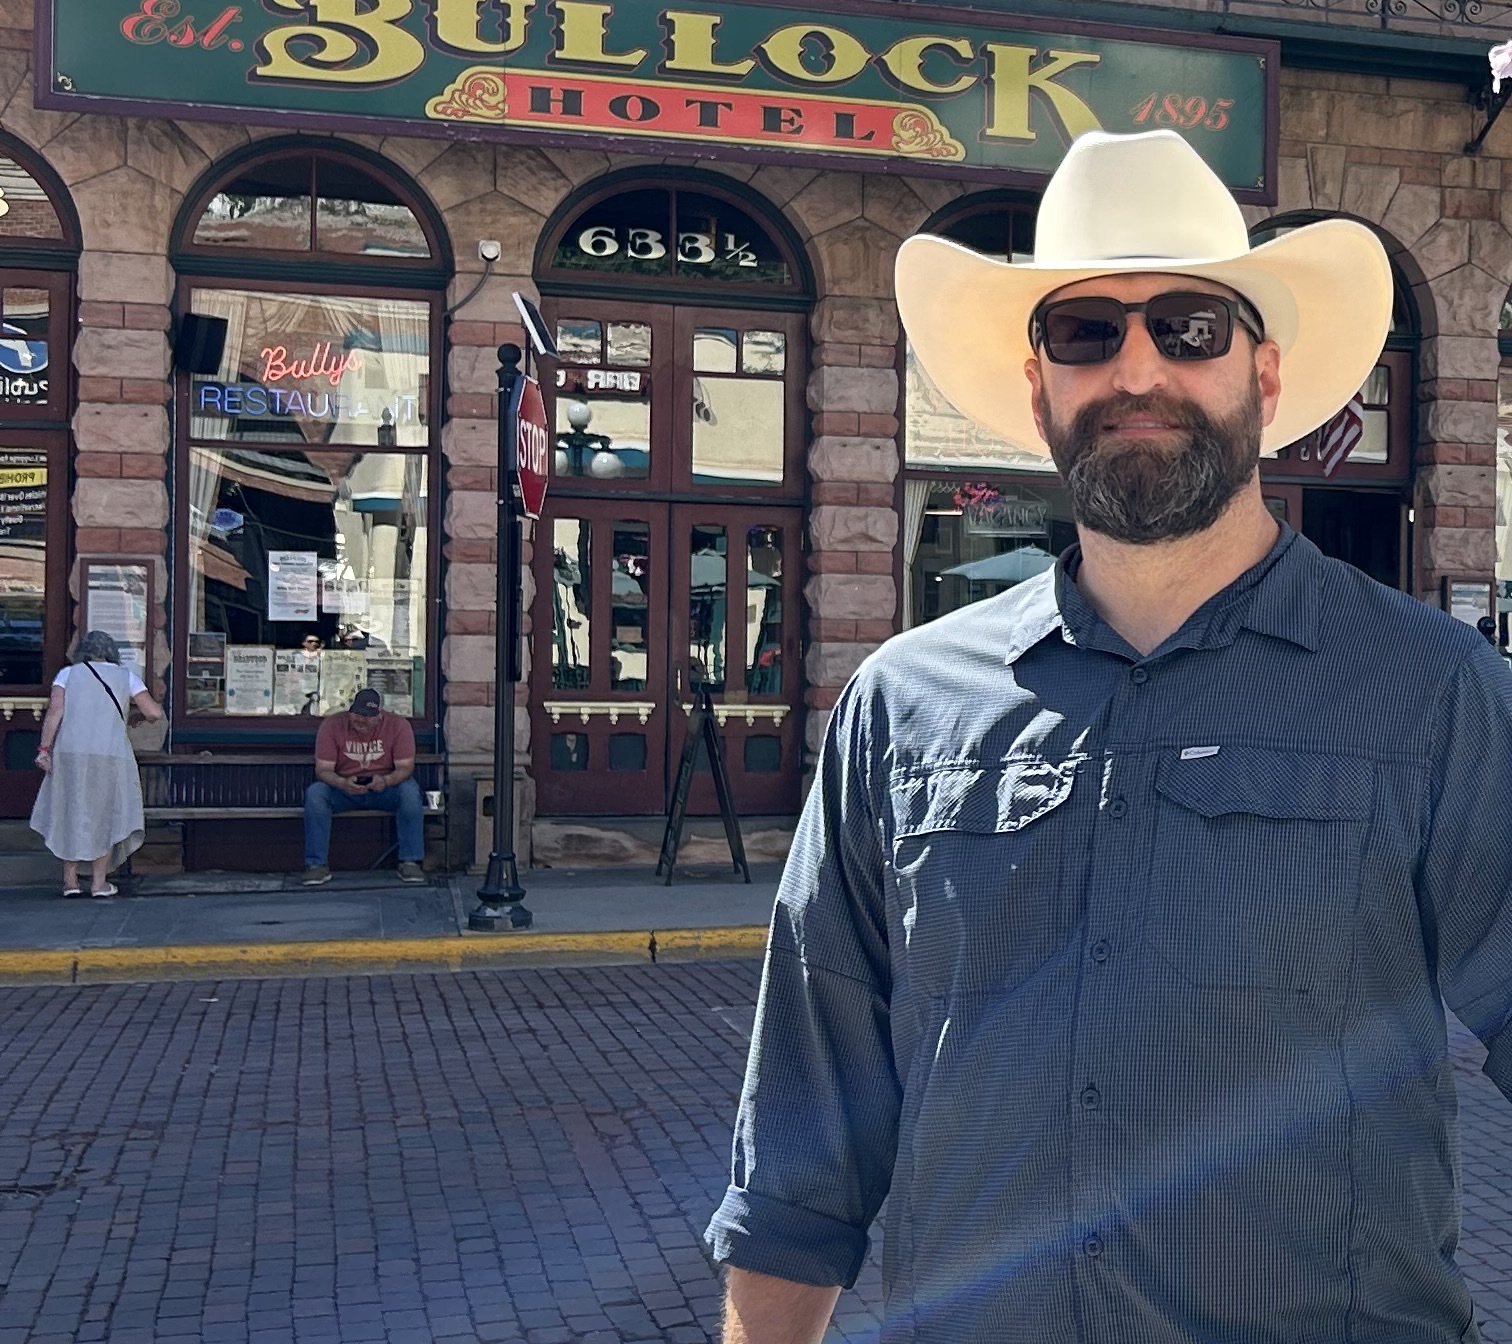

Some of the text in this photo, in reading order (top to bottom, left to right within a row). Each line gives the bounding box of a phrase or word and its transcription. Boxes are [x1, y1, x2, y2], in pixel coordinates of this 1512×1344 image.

[529, 85, 875, 141] HOTEL
[1131, 91, 1235, 131] 1895
[519, 418, 546, 476] STOP
[966, 504, 1048, 526] VACANCY
